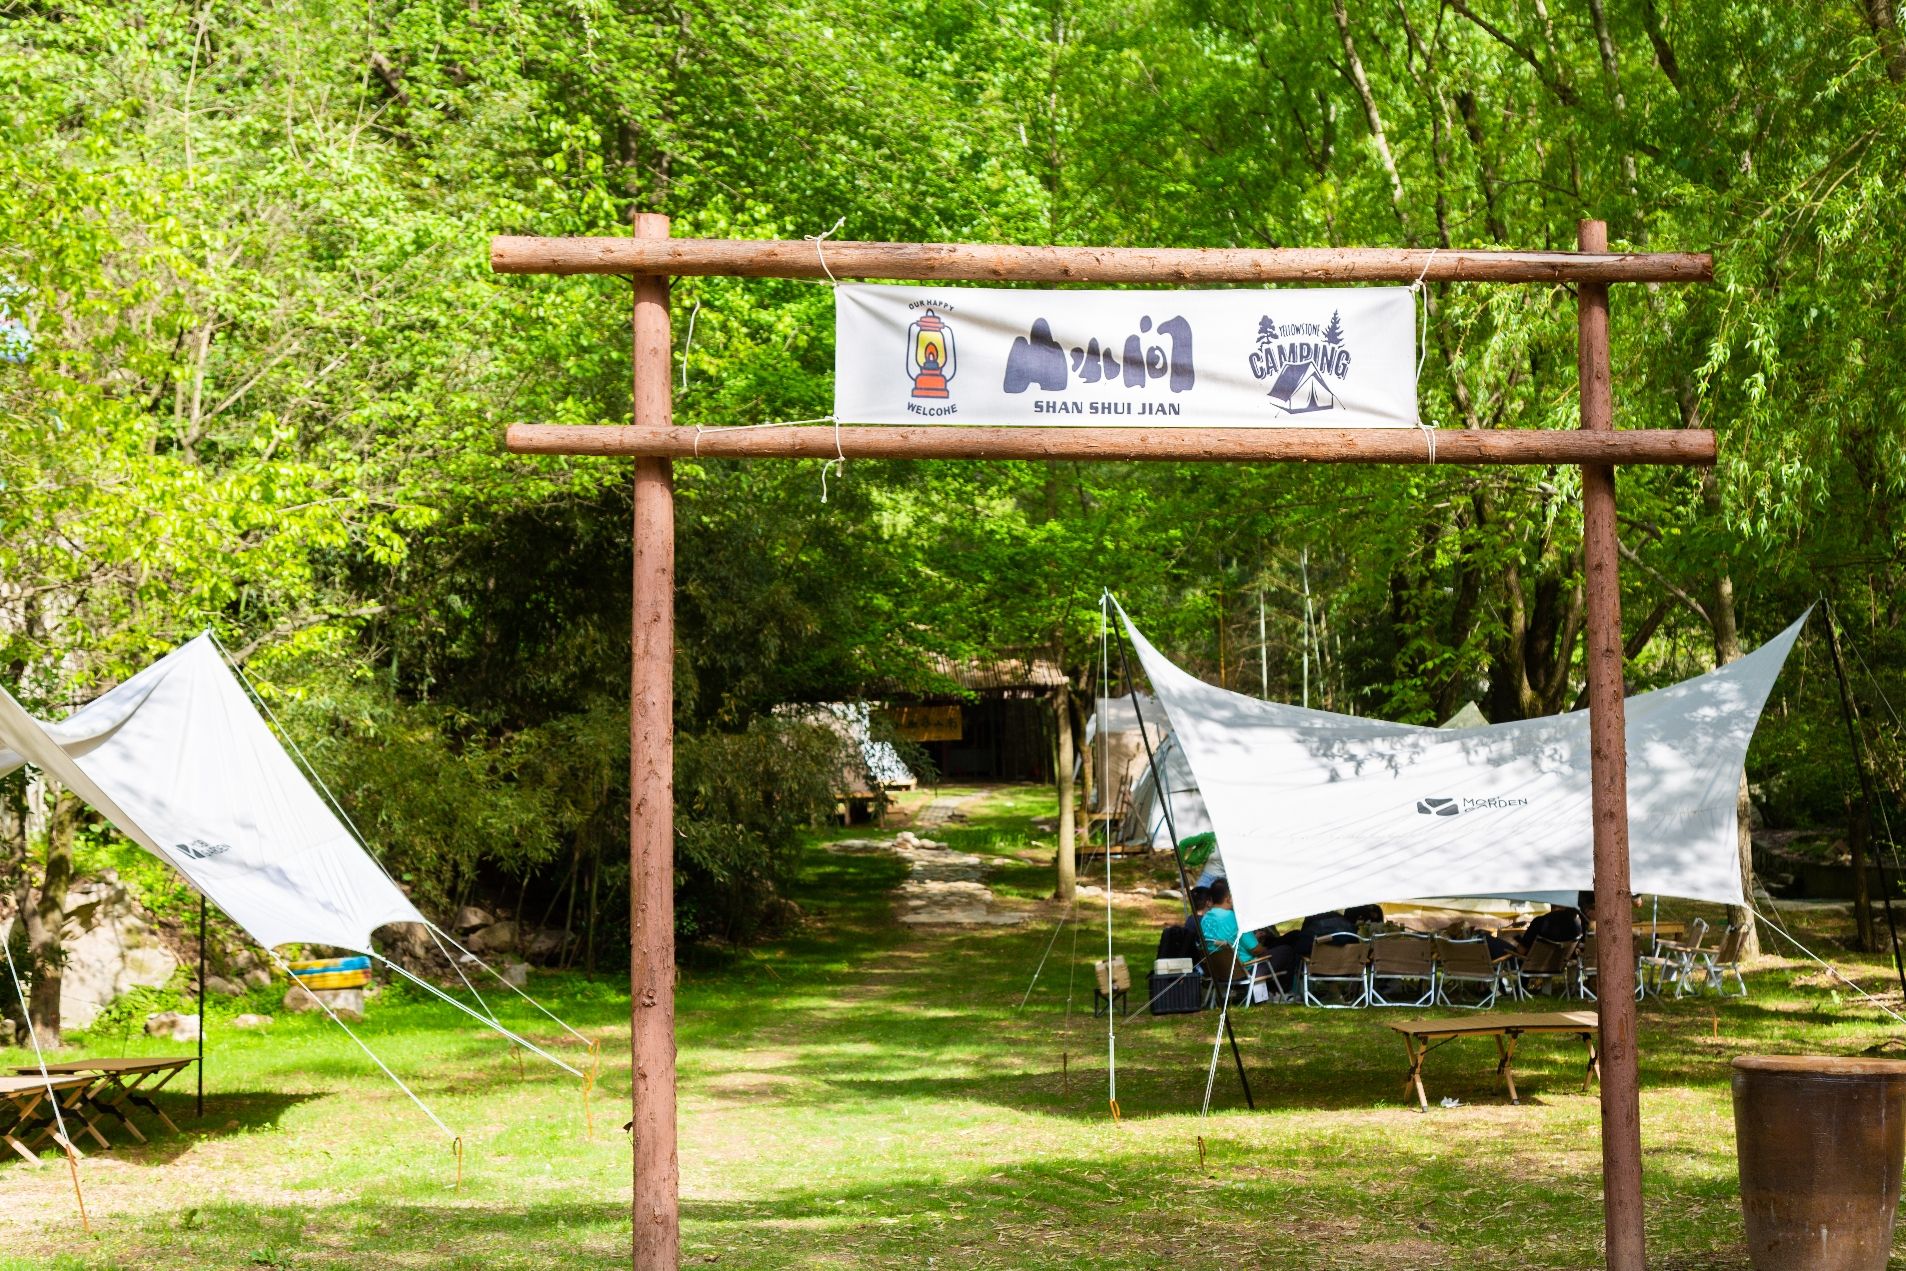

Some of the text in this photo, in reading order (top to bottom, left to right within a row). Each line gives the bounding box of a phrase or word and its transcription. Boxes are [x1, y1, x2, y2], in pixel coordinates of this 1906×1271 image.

[908, 299, 954, 312] OUR HAPPY
[1279, 322, 1320, 337] YELLOWSTONE
[1249, 342, 1351, 380] CAMPING
[1034, 400, 1180, 415] SHAN SHUI JIAN
